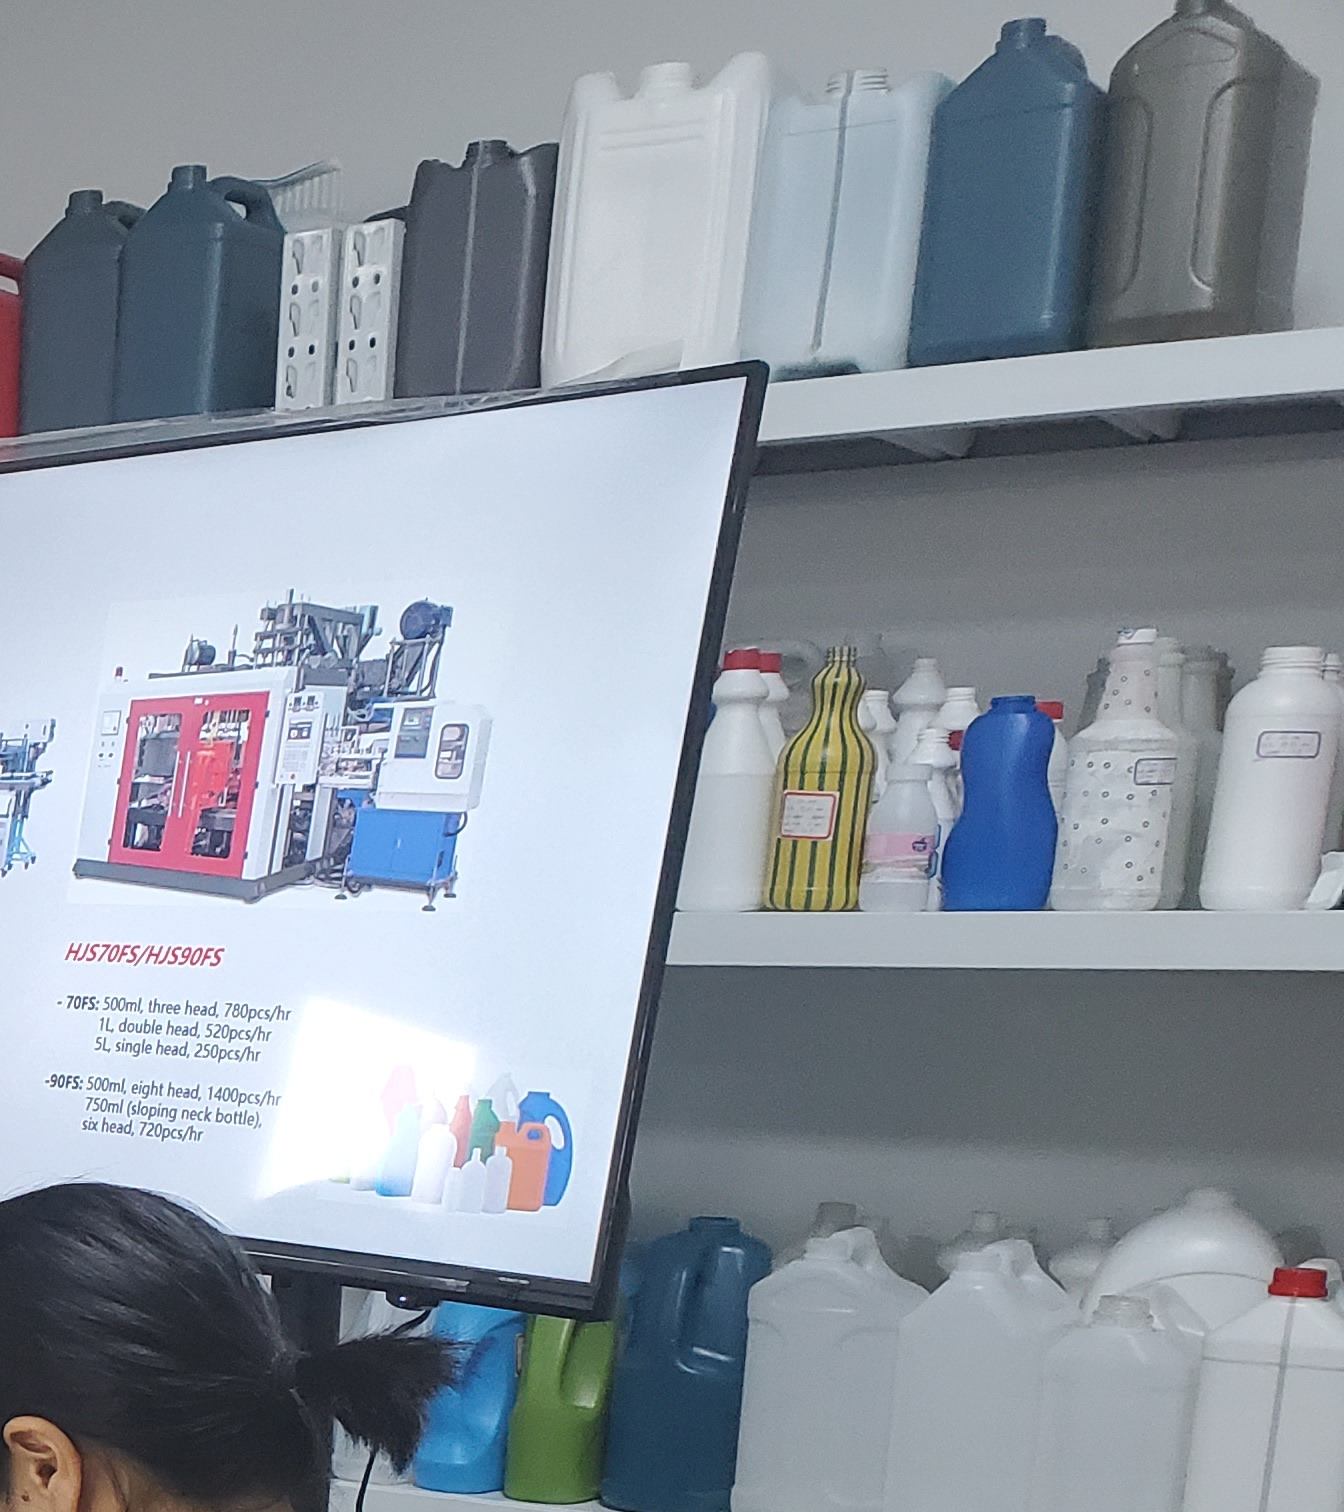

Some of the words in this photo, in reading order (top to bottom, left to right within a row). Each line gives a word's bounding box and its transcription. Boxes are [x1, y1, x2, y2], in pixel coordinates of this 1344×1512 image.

[65, 943, 225, 967] HJS70FS/HJS90FS
[102, 997, 144, 1013] 500ml,
[148, 999, 181, 1015] three
[184, 1000, 219, 1018] head,
[224, 1003, 292, 1023] 780pcs/hr
[118, 1018, 162, 1035] double
[166, 1020, 201, 1039] head,
[204, 1023, 272, 1043] 520pcs/hr
[115, 1038, 152, 1057] single
[155, 1040, 190, 1059] head,
[193, 1043, 261, 1064] 250pcs/hr
[86, 1077, 127, 1095] 500ml,
[131, 1080, 164, 1099] eight
[166, 1082, 202, 1102] head,
[207, 1086, 282, 1107] 1400pcs/hr
[85, 1096, 123, 1114] 750ml
[127, 1101, 177, 1122] (sloping
[181, 1106, 212, 1122] neck
[215, 1108, 263, 1130] bottle),
[82, 1118, 98, 1132] six
[101, 1120, 135, 1137] head,
[139, 1121, 204, 1142] 720pcs/hr
